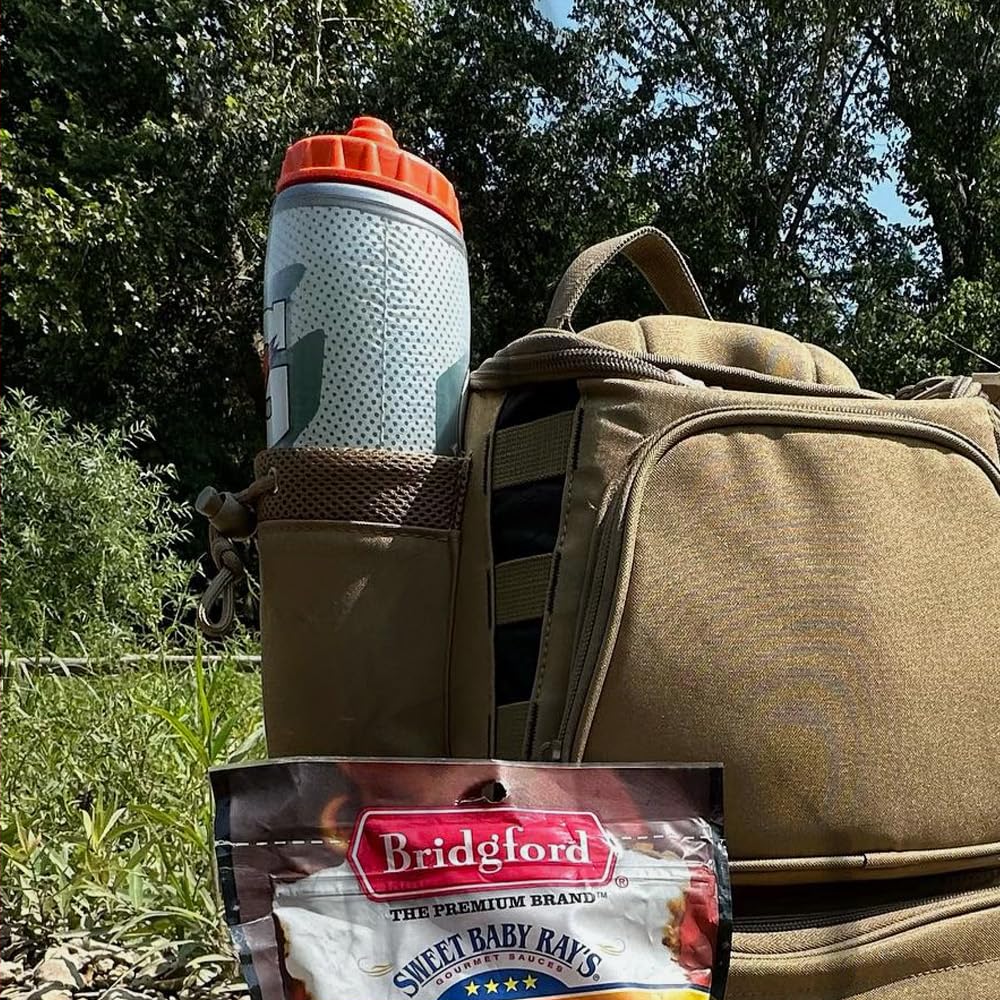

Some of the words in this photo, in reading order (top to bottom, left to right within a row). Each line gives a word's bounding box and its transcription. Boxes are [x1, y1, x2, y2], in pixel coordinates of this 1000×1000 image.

[379, 824, 592, 874] Bridgford
[390, 907, 429, 921] THE
[434, 896, 526, 918] PREMIUM
[393, 930, 465, 998] SWEET
[468, 923, 532, 953] BABY
[436, 954, 499, 985] GOURMET
[509, 953, 563, 973] SAUCES
